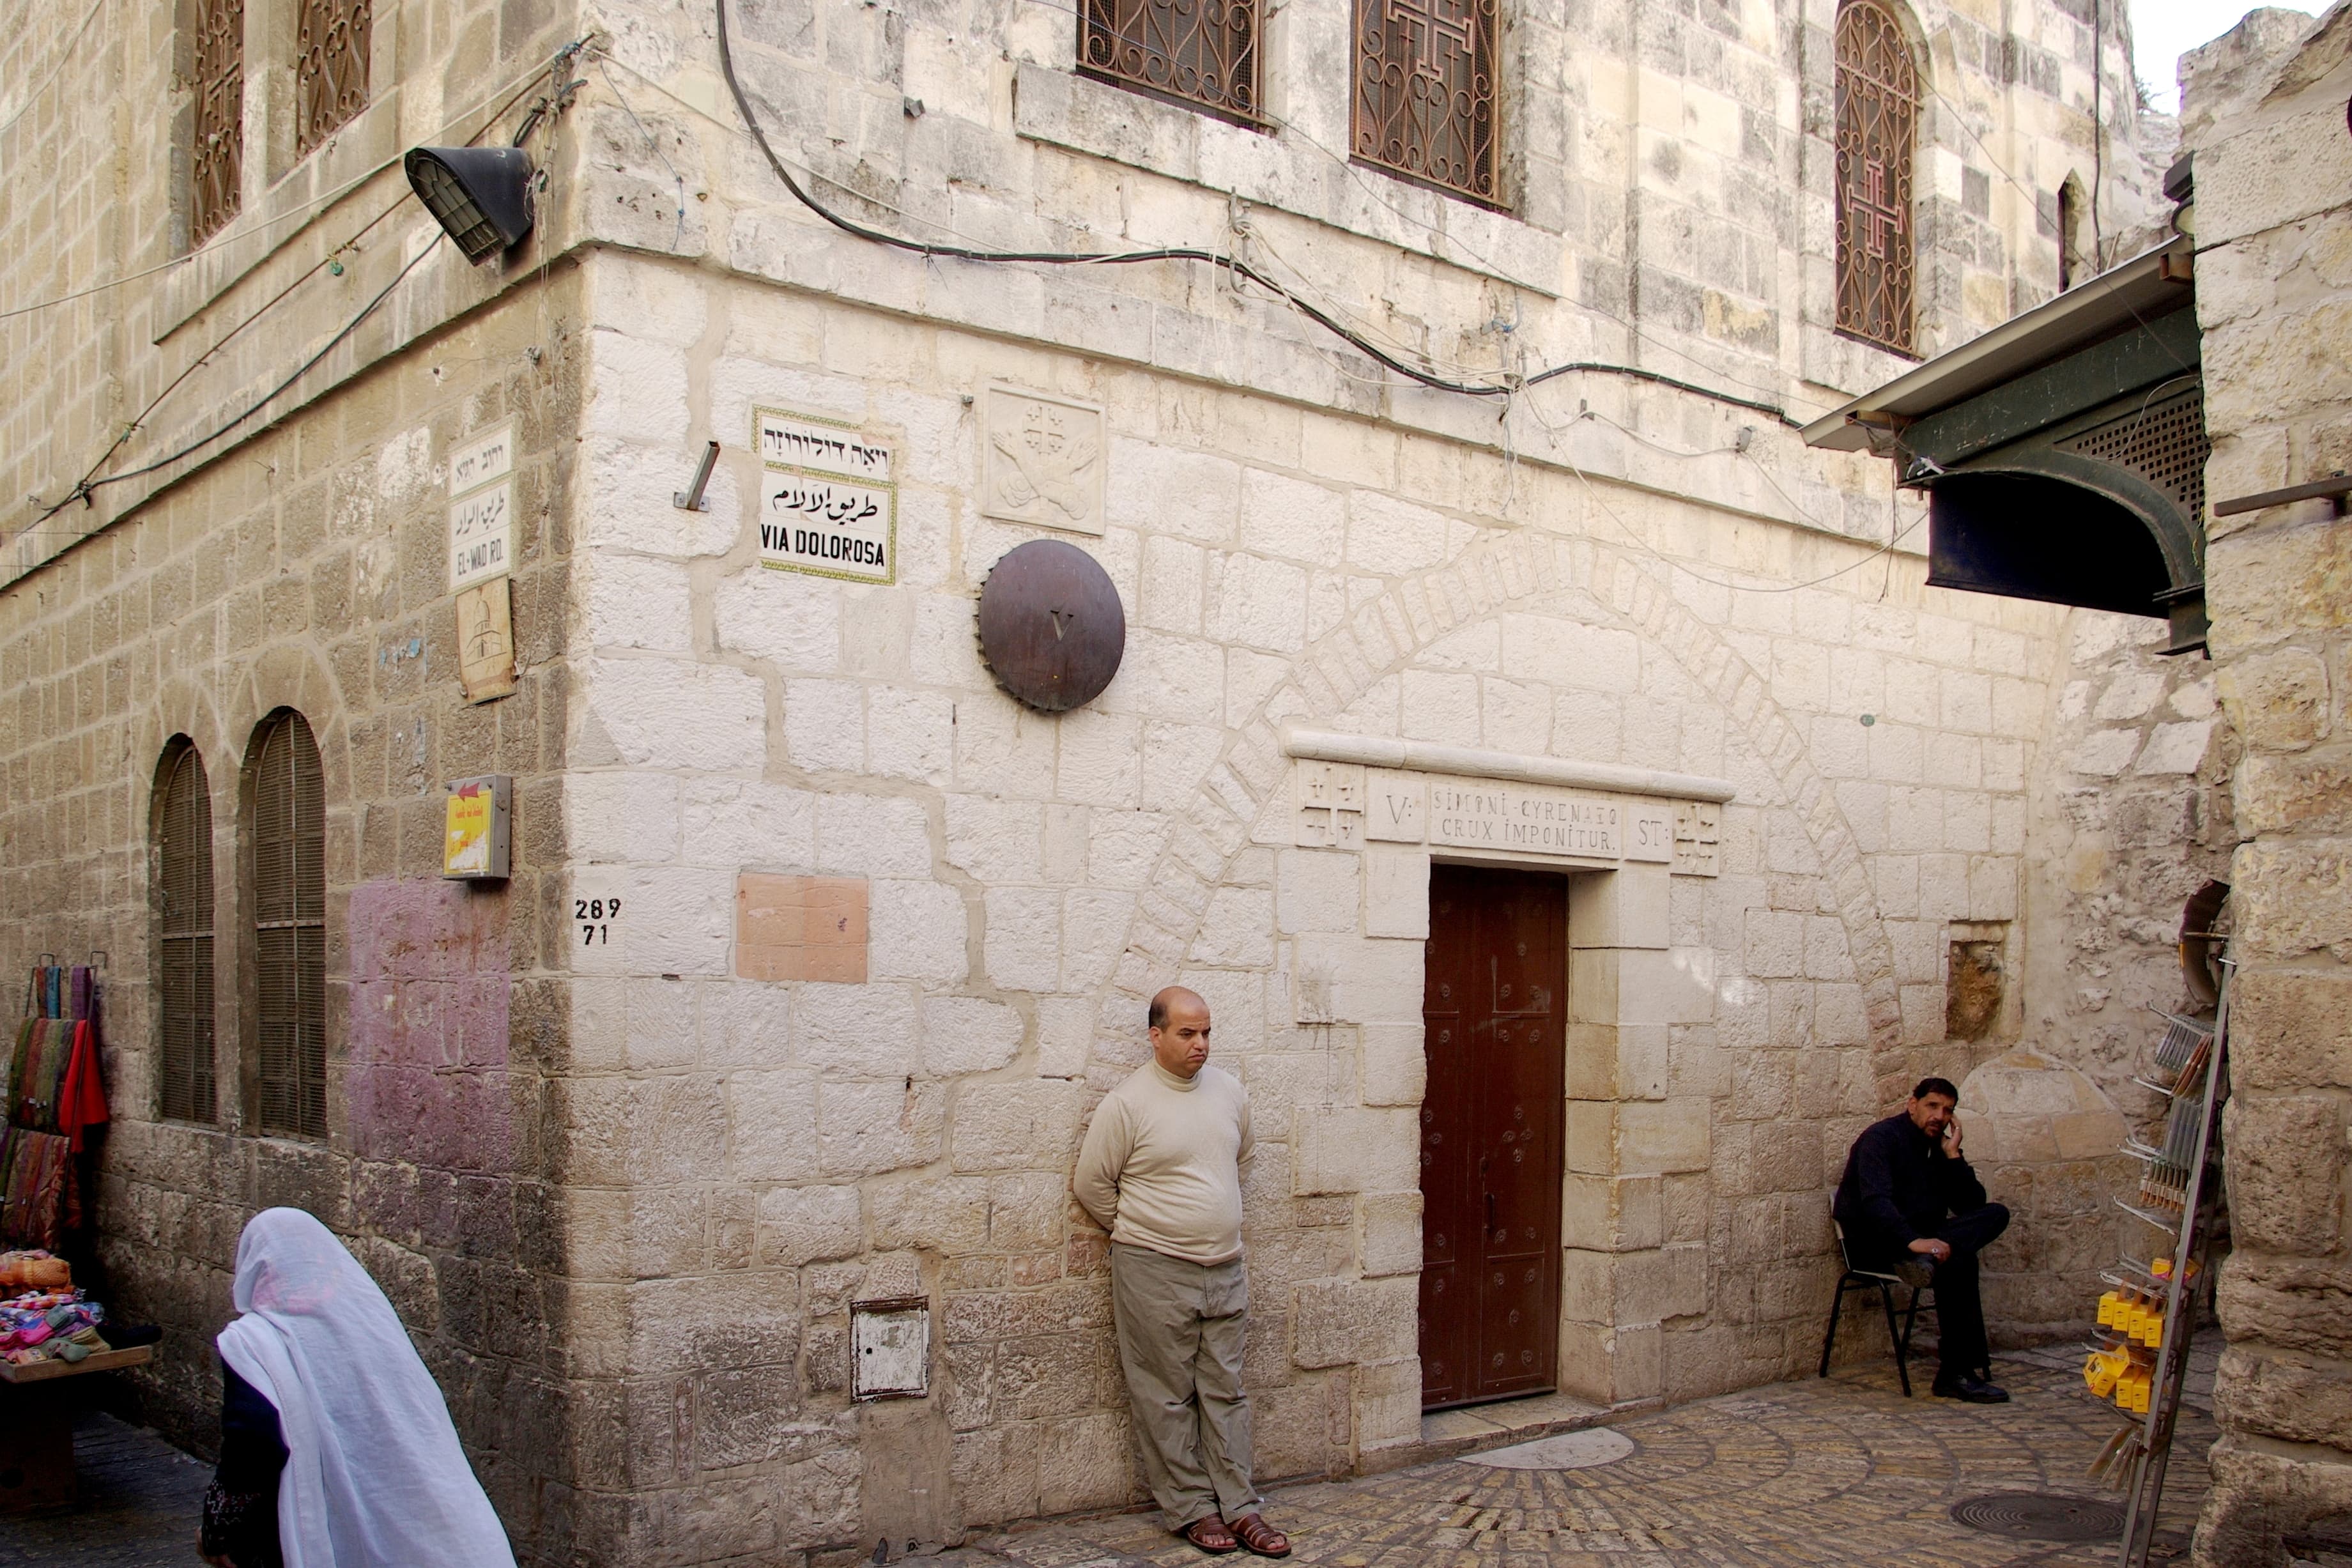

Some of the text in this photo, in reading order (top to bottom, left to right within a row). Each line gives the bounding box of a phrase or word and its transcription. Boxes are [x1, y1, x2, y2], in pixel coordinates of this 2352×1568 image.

[480, 489, 504, 530] طريق
[825, 493, 878, 525] طريق
[457, 537, 503, 576] EL-WAD RD.
[761, 523, 885, 567] VIA DOLOROSA
[1050, 610, 1074, 641] V
[1442, 819, 1493, 840] CRUX
[575, 898, 621, 919] 289
[583, 924, 607, 946] 71
